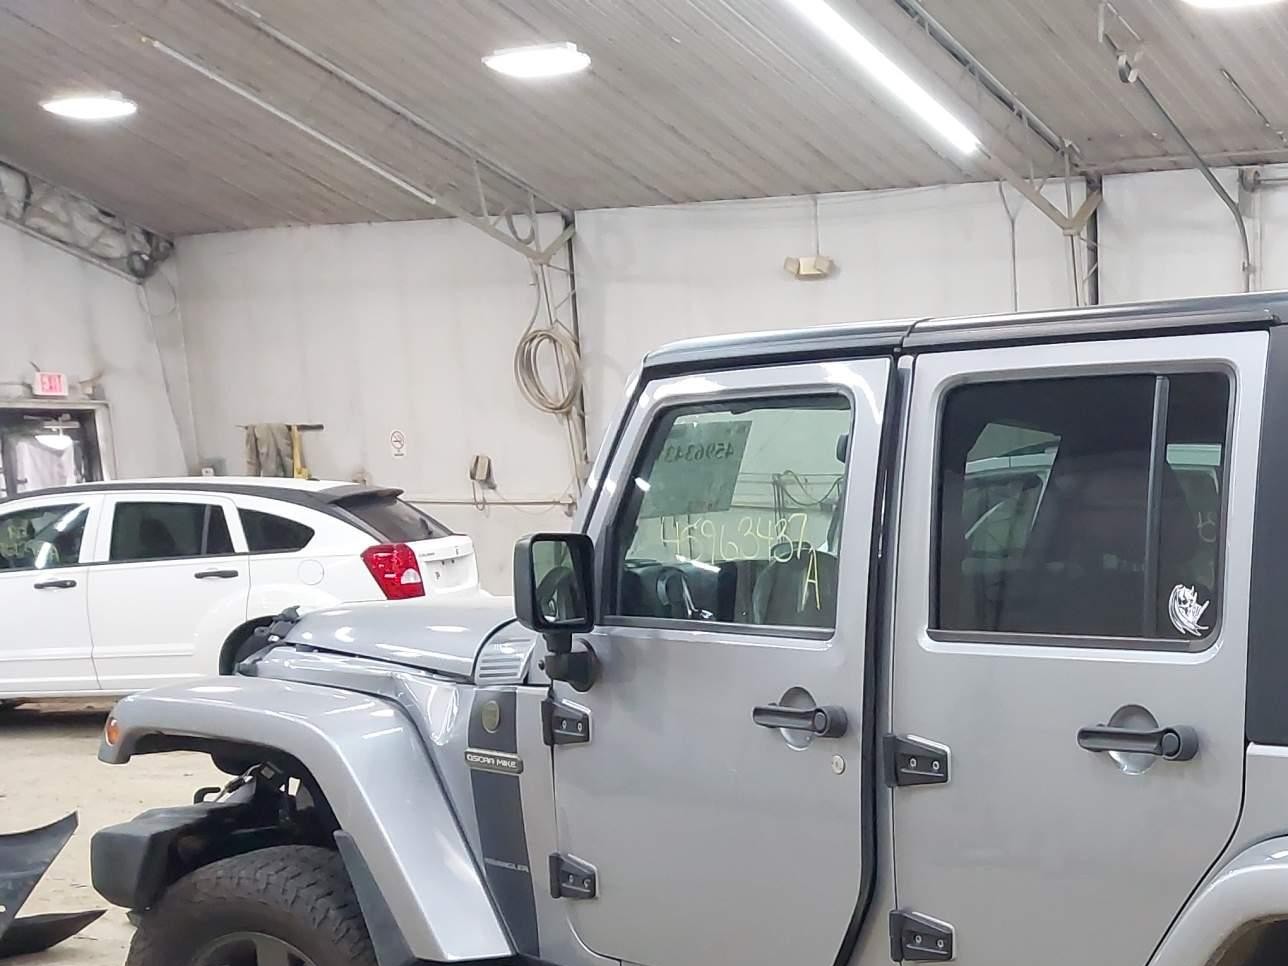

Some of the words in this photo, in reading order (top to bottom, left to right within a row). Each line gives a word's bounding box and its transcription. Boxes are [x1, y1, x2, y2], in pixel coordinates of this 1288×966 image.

[40, 374, 62, 392] EXIT
[660, 513, 808, 564] 45963437
[799, 547, 822, 612] A
[466, 753, 495, 765] OSCAR
[496, 758, 517, 768] MIKE
